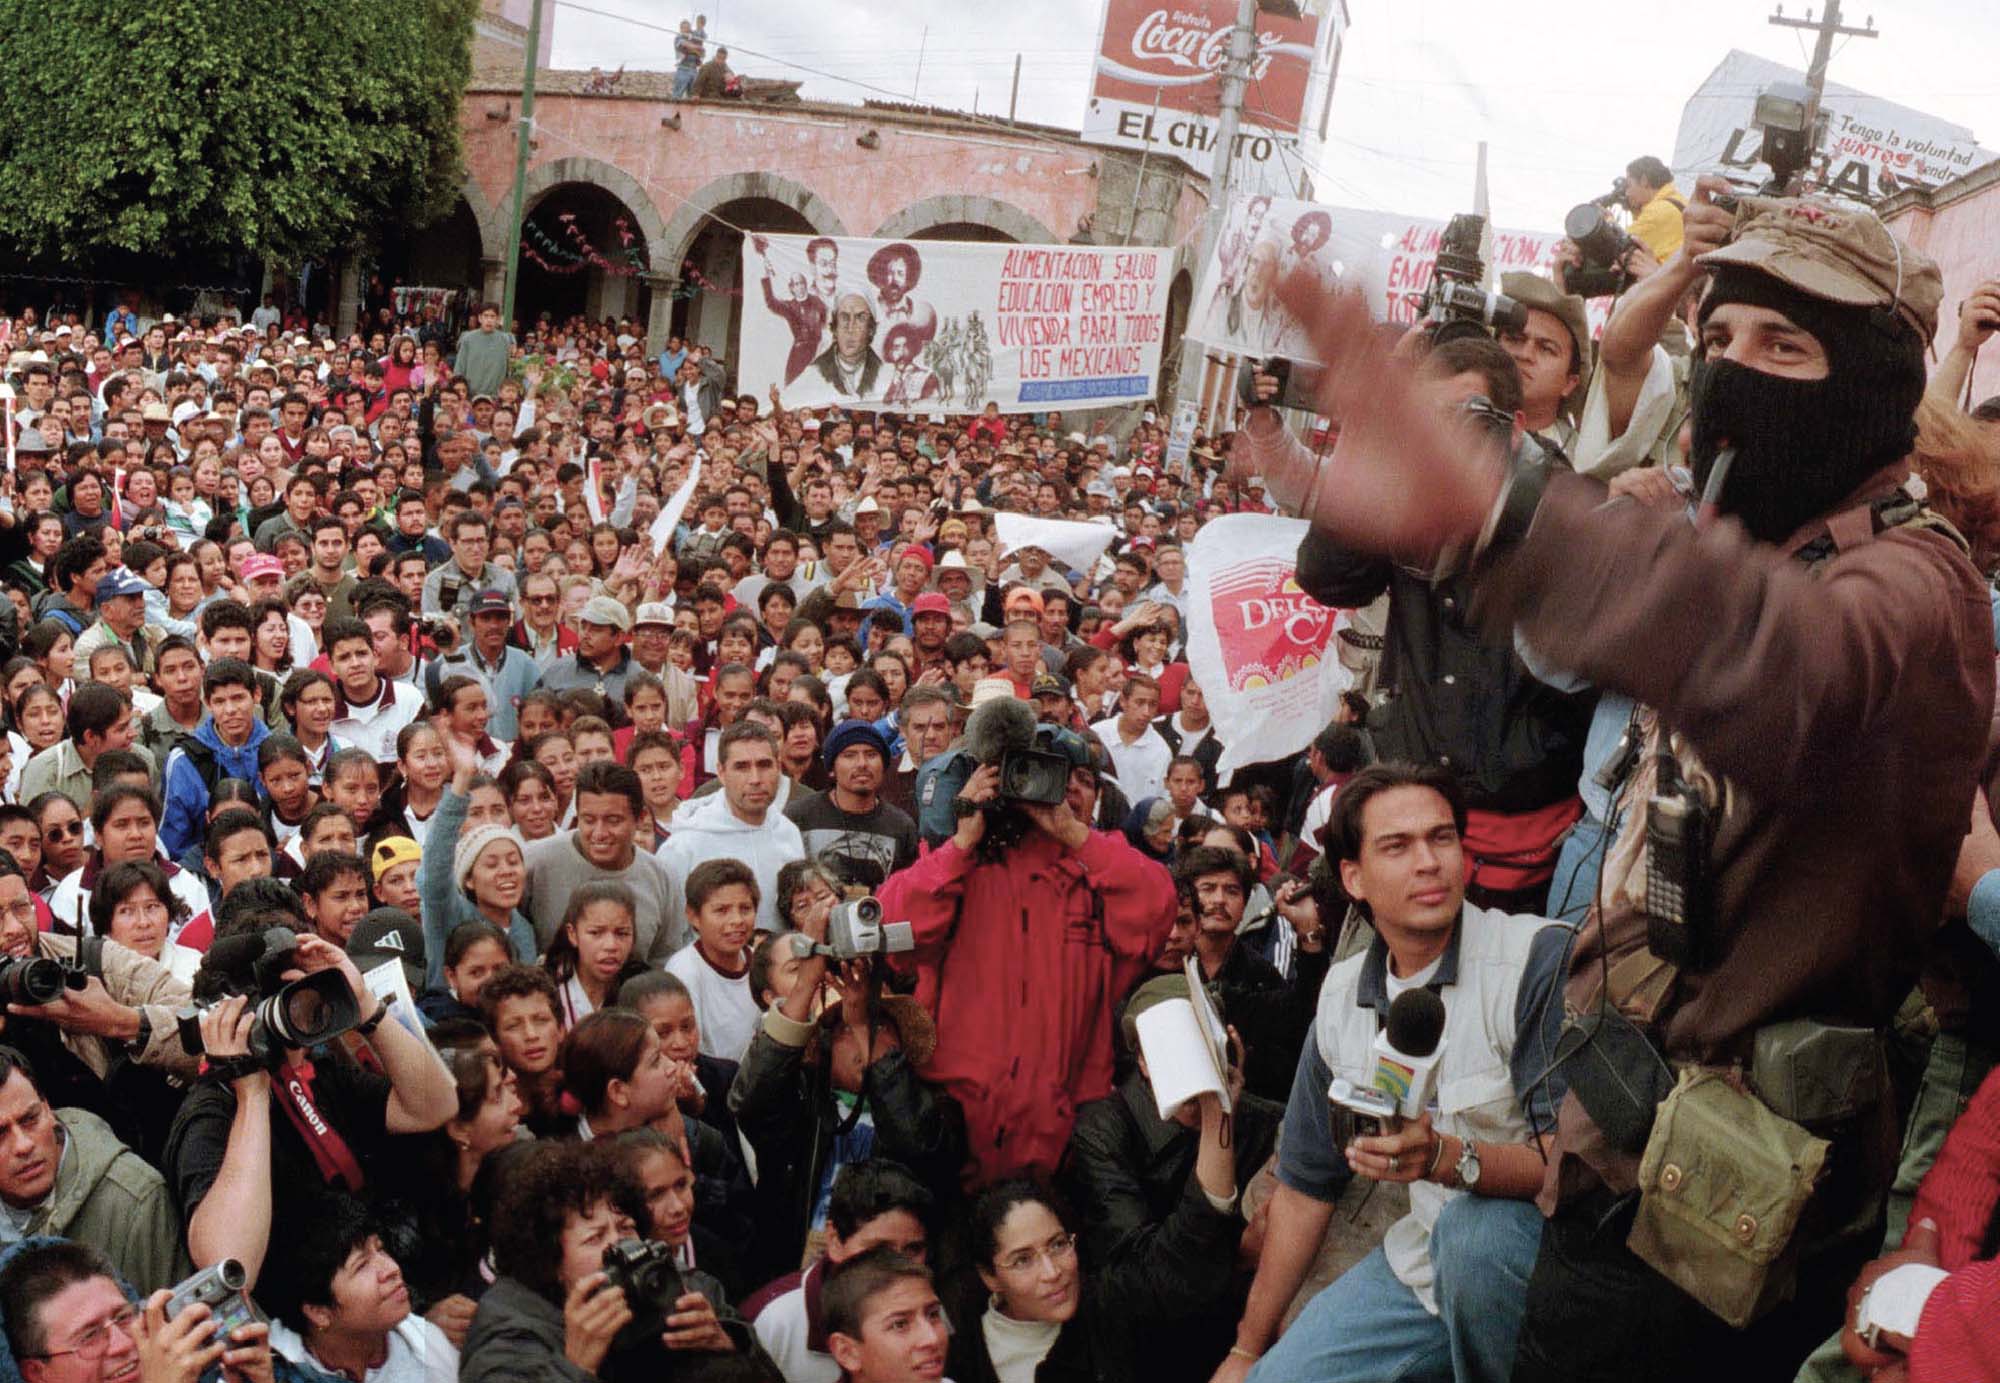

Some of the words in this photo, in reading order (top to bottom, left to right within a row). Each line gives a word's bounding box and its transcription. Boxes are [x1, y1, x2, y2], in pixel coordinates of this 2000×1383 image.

[1117, 110, 1159, 143] EL
[1840, 114, 1883, 141] Tengo
[1887, 130, 1900, 147] la
[1905, 139, 1973, 166] voluntad
[1001, 248, 1104, 281] ALIMENTACION
[1113, 254, 1157, 280] SALUD
[998, 282, 1074, 313] EDUCACION
[1081, 283, 1139, 313] EMPLEO
[1145, 283, 1157, 311] Y
[998, 315, 1071, 347] VIVIENDA
[1080, 315, 1117, 344] PARA
[1125, 313, 1161, 343] TODOS
[1019, 349, 1051, 379] LOS
[1059, 346, 1141, 377] MEXICANOS
[289, 1080, 328, 1136] Canon
